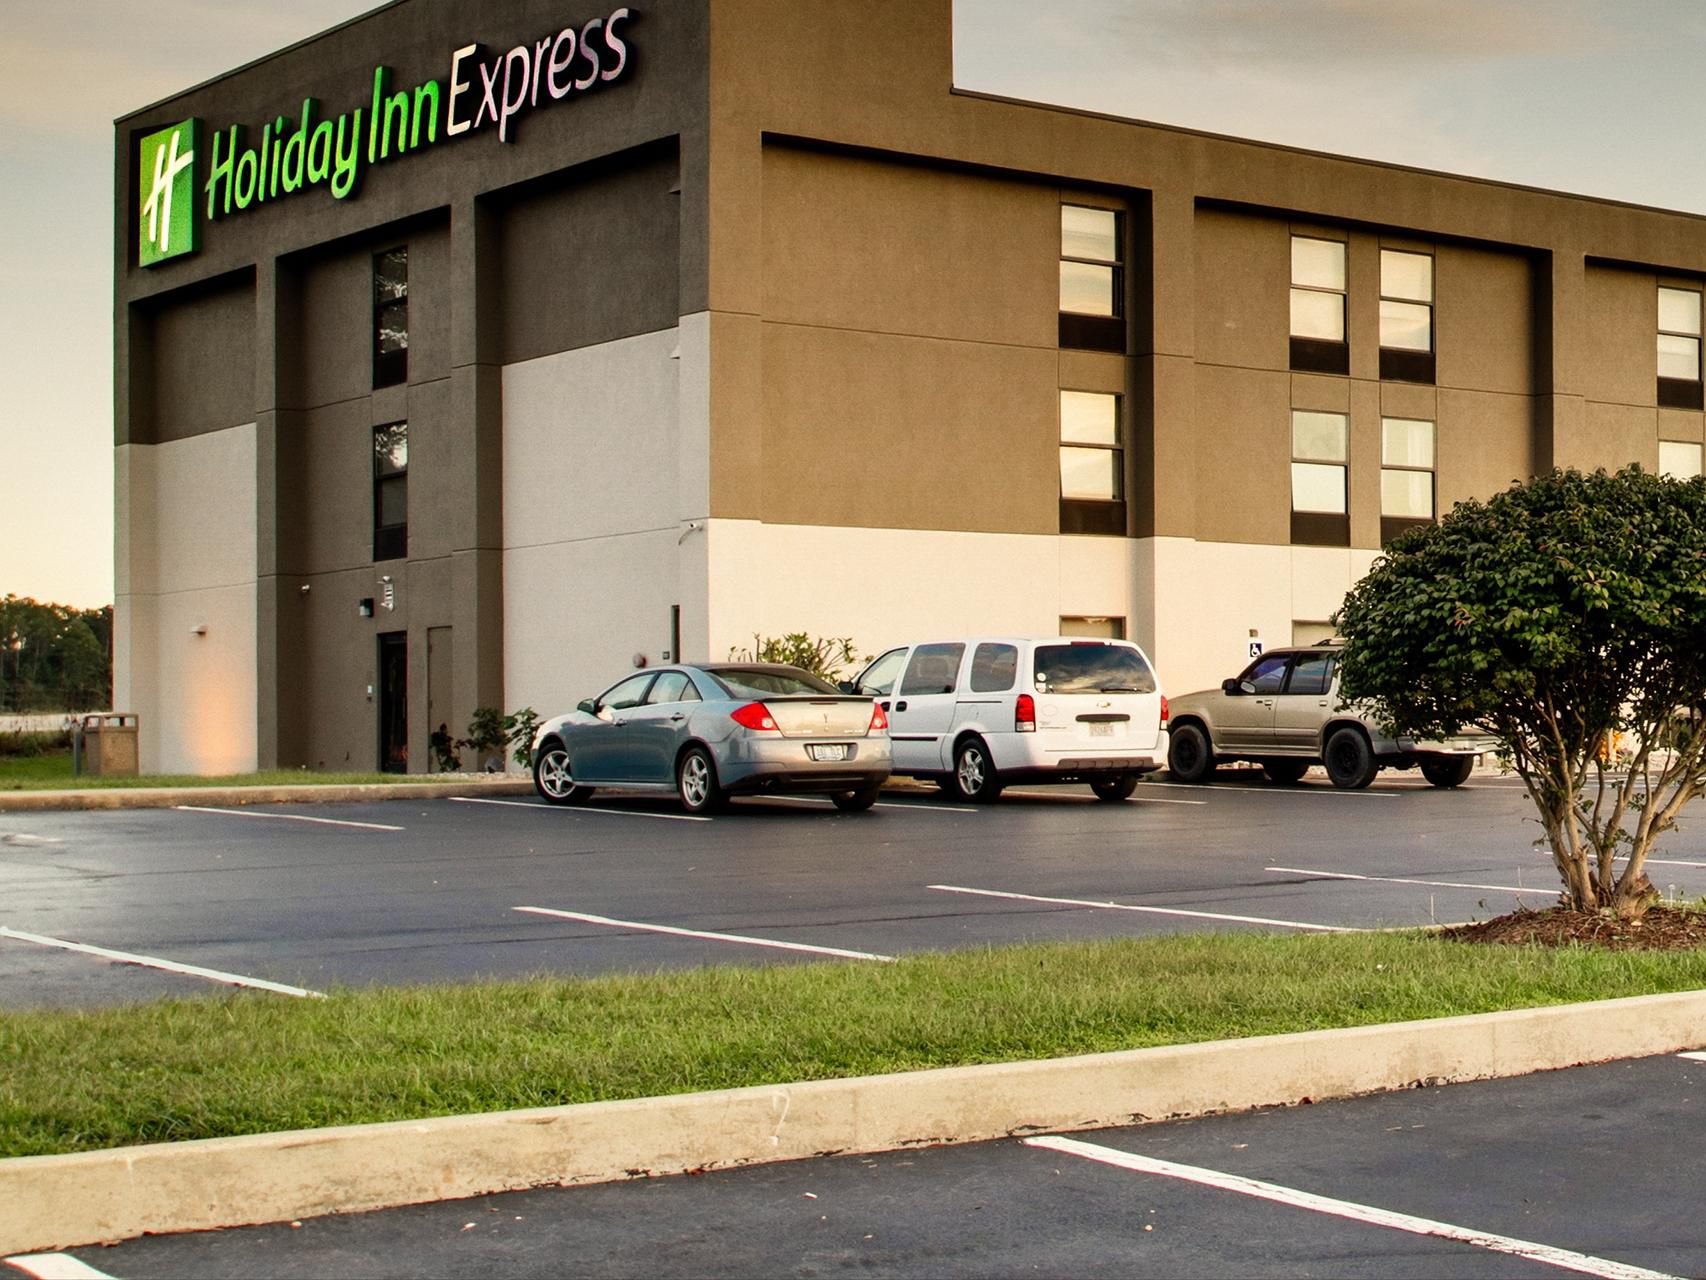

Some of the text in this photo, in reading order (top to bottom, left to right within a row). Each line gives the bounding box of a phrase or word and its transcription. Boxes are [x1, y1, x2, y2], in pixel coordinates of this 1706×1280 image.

[205, 7, 632, 220] Holiday Inn Express
